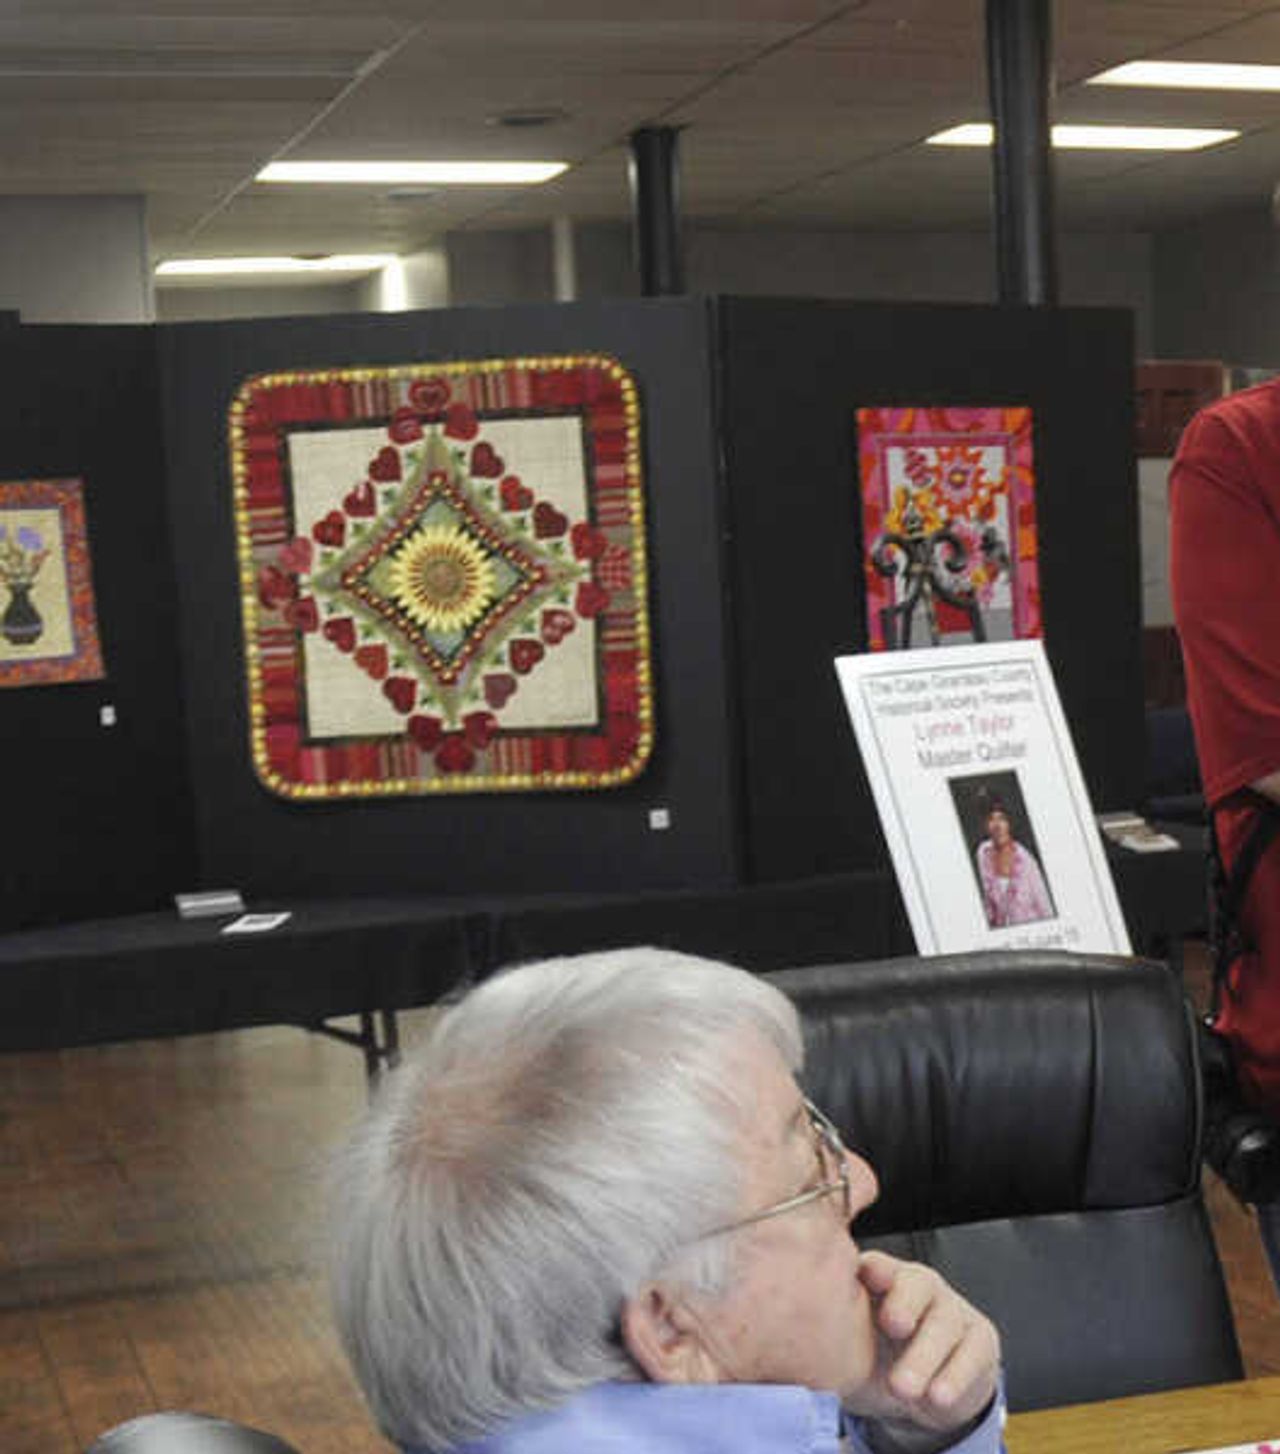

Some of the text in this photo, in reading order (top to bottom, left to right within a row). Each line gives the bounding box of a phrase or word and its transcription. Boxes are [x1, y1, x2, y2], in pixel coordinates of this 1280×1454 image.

[966, 714, 1013, 737] Taylor
[917, 742, 1027, 769] Master Quilter
